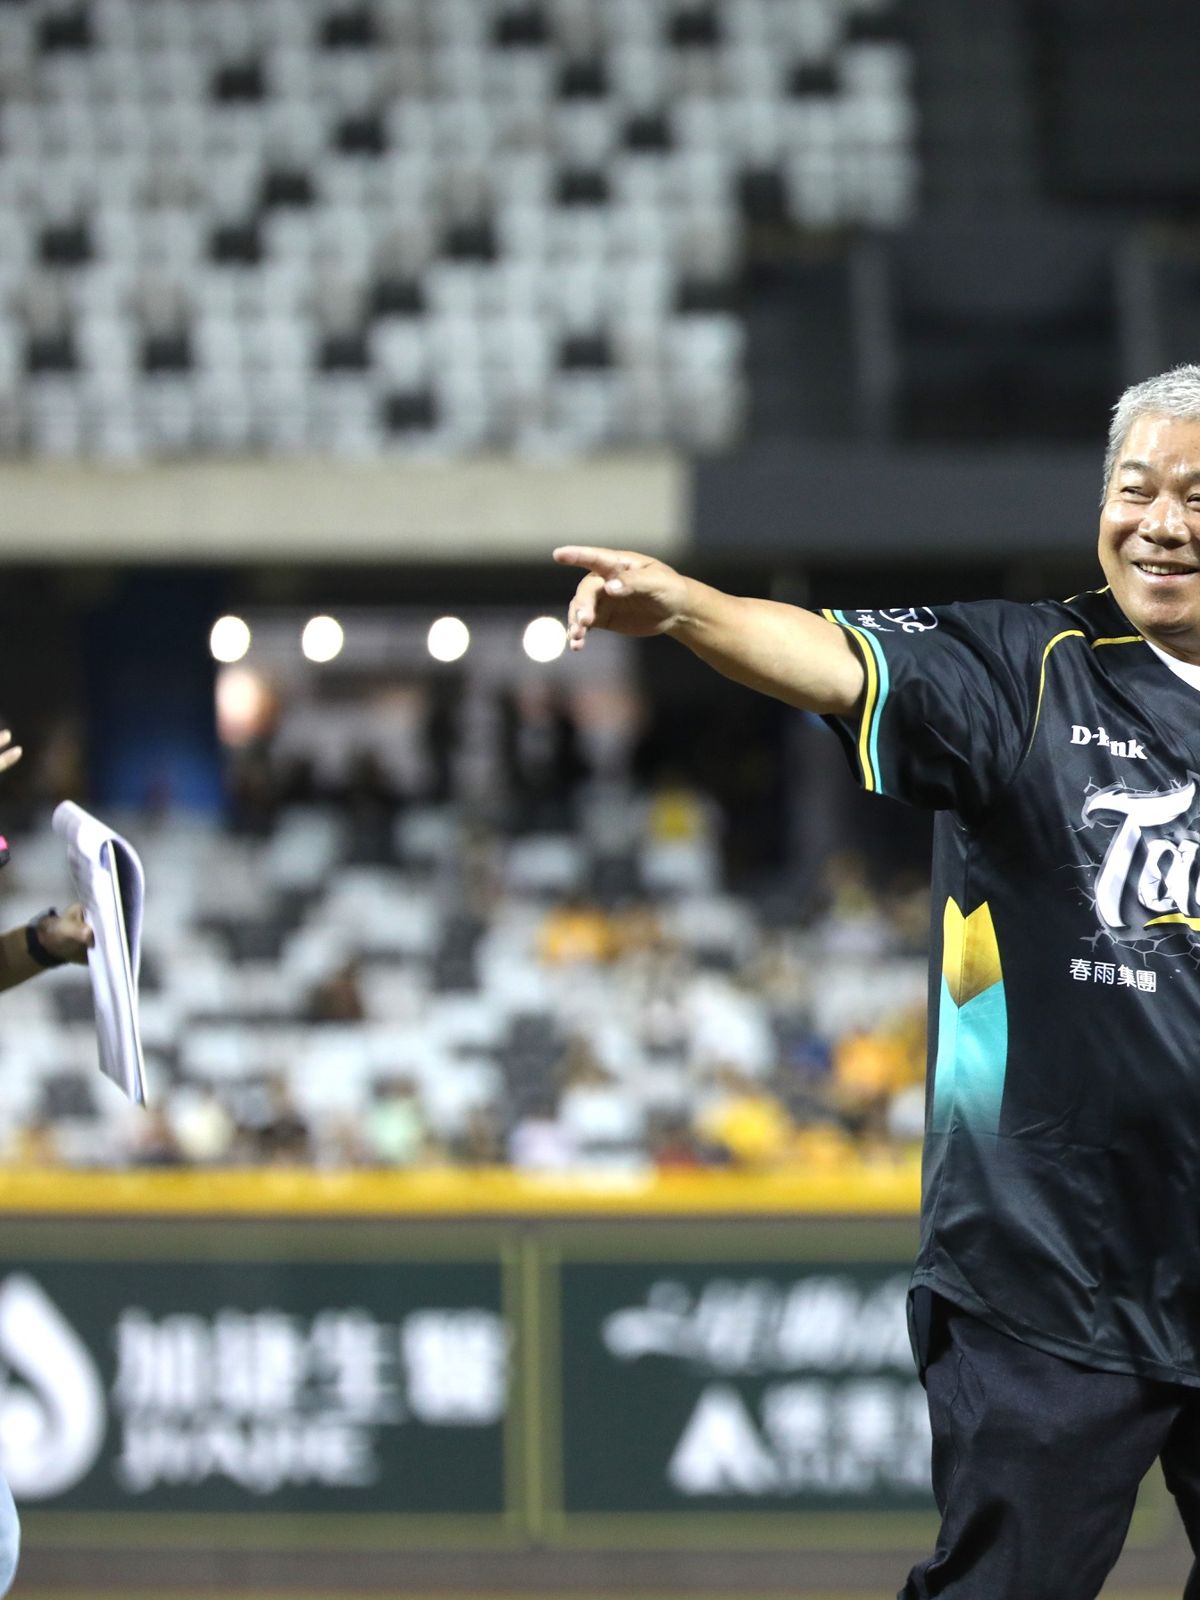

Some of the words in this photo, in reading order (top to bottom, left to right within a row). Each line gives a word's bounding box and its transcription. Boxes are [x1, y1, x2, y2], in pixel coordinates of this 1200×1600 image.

[1070, 725, 1148, 760] D-Lnk
[1069, 958, 1157, 993] 春雨集團
